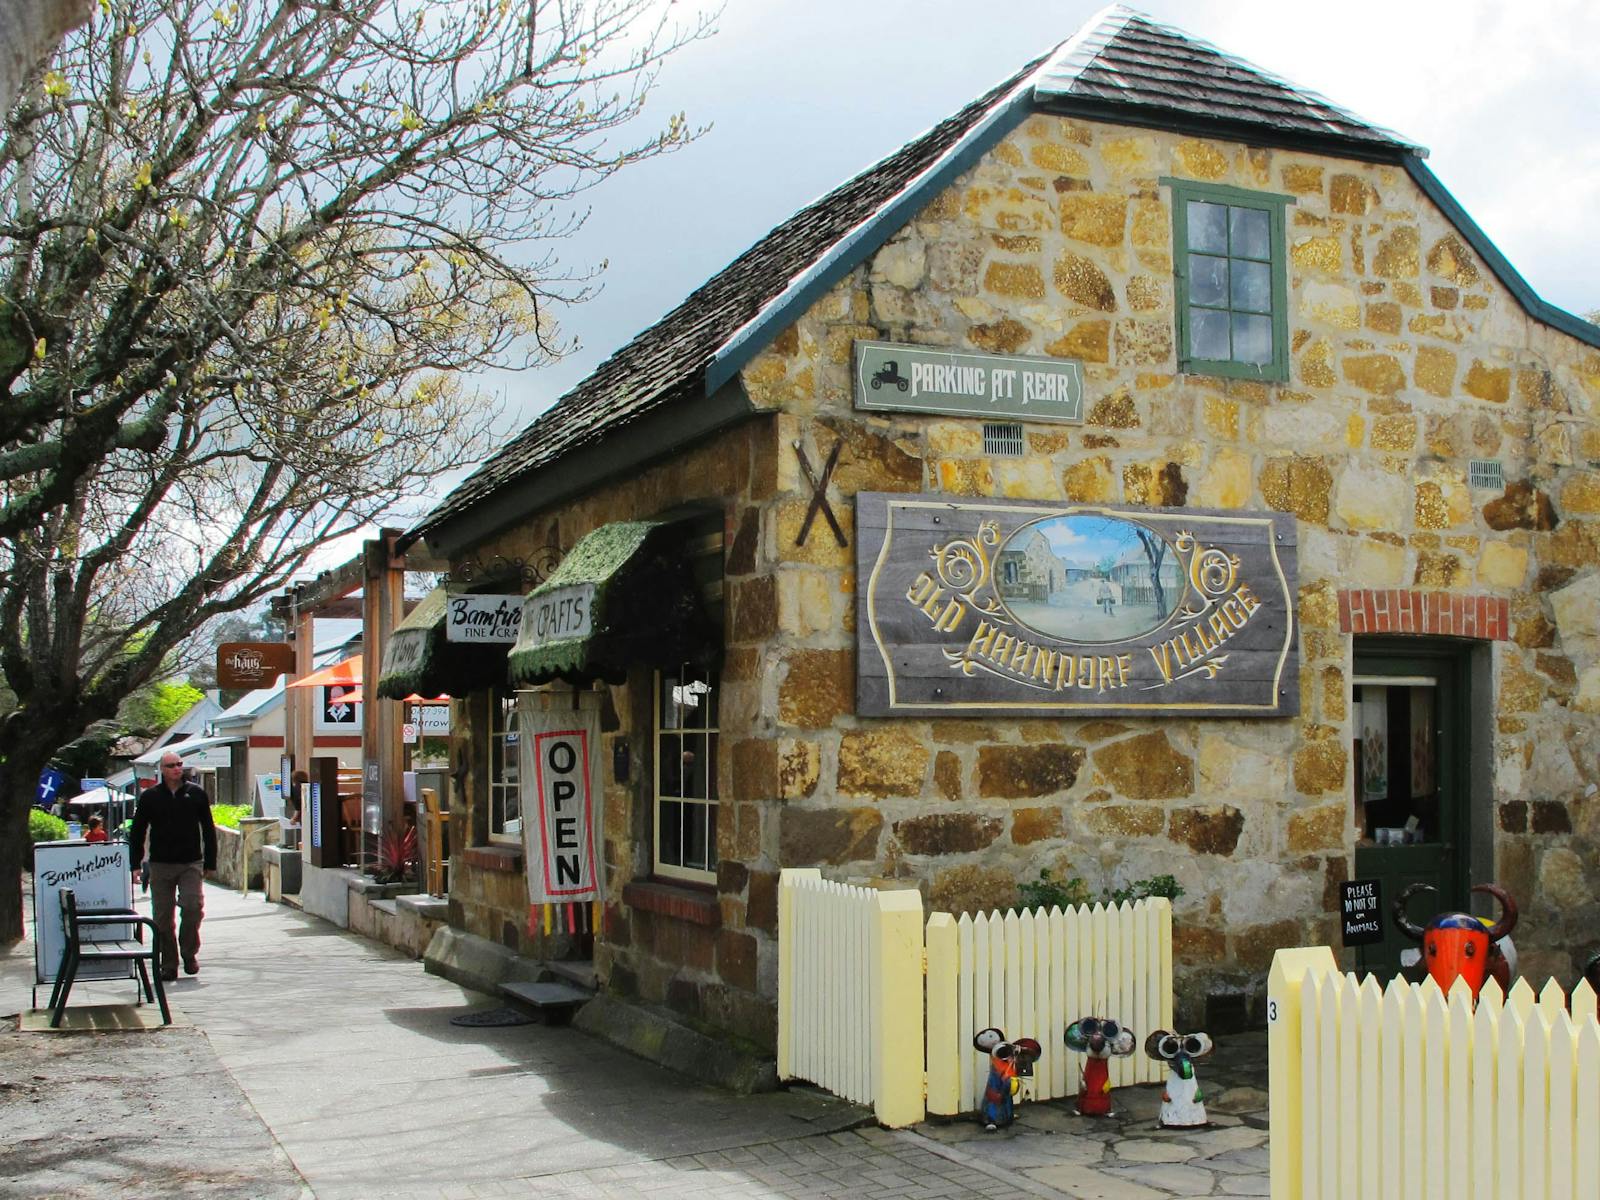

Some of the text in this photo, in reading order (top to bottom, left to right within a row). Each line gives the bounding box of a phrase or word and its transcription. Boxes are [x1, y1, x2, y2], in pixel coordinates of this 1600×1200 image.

[911, 363, 1070, 404] PARKING AT REAR
[465, 627, 486, 638] FINE
[537, 596, 584, 638] CRAFTS
[905, 571, 1262, 694] OLD HAHNDORF VILLAGE
[549, 741, 581, 886] OPEN
[41, 851, 122, 887] Bamfurlong
[1344, 896, 1377, 912] DO NOT SIT
[1347, 883, 1373, 898] PLEASE
[1269, 1001, 1277, 1021] 3
